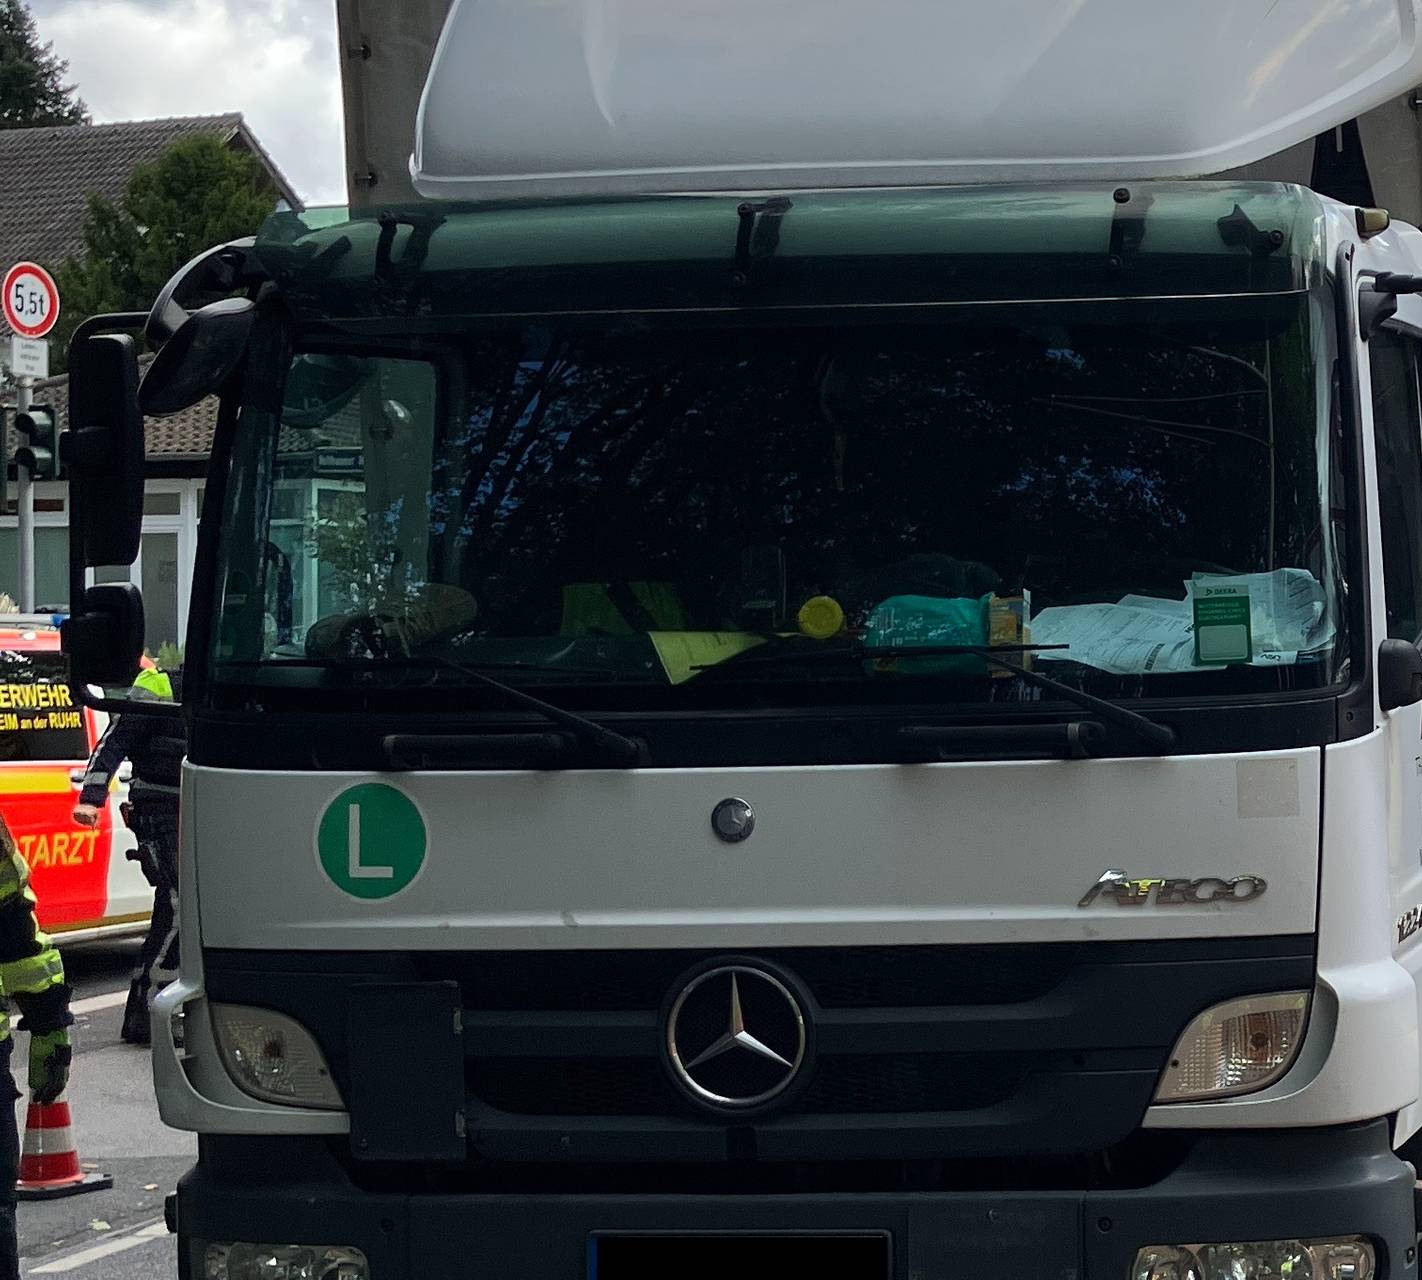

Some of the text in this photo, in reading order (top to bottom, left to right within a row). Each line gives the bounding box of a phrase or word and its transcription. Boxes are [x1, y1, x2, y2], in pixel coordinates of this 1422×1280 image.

[20, 718, 33, 729] an
[33, 716, 48, 730] der
[48, 711, 82, 729] RUHR
[349, 803, 393, 878] L
